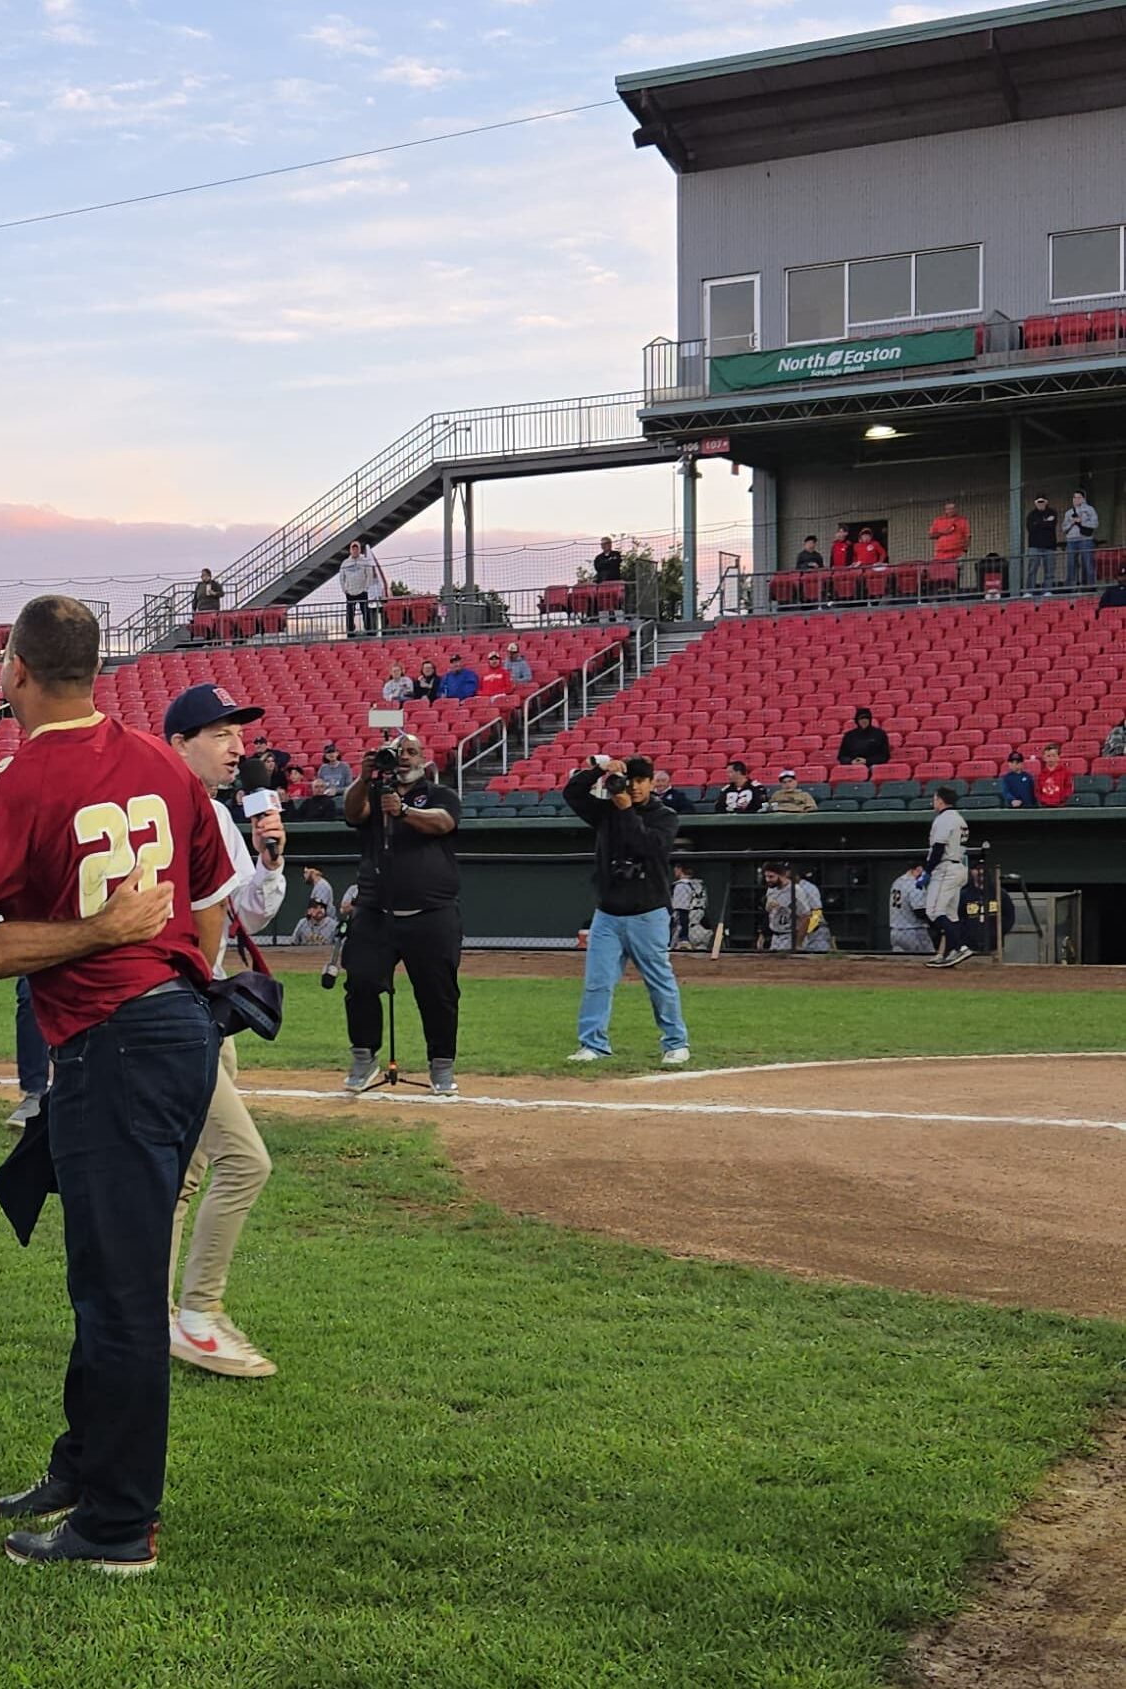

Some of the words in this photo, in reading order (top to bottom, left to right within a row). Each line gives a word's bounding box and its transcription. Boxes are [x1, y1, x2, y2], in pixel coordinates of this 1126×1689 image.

[777, 353, 825, 372] North
[842, 347, 902, 365] Easton
[810, 367, 842, 377] Savings
[843, 364, 865, 374] Bank
[705, 440, 723, 450] 107
[73, 794, 174, 919] 22
